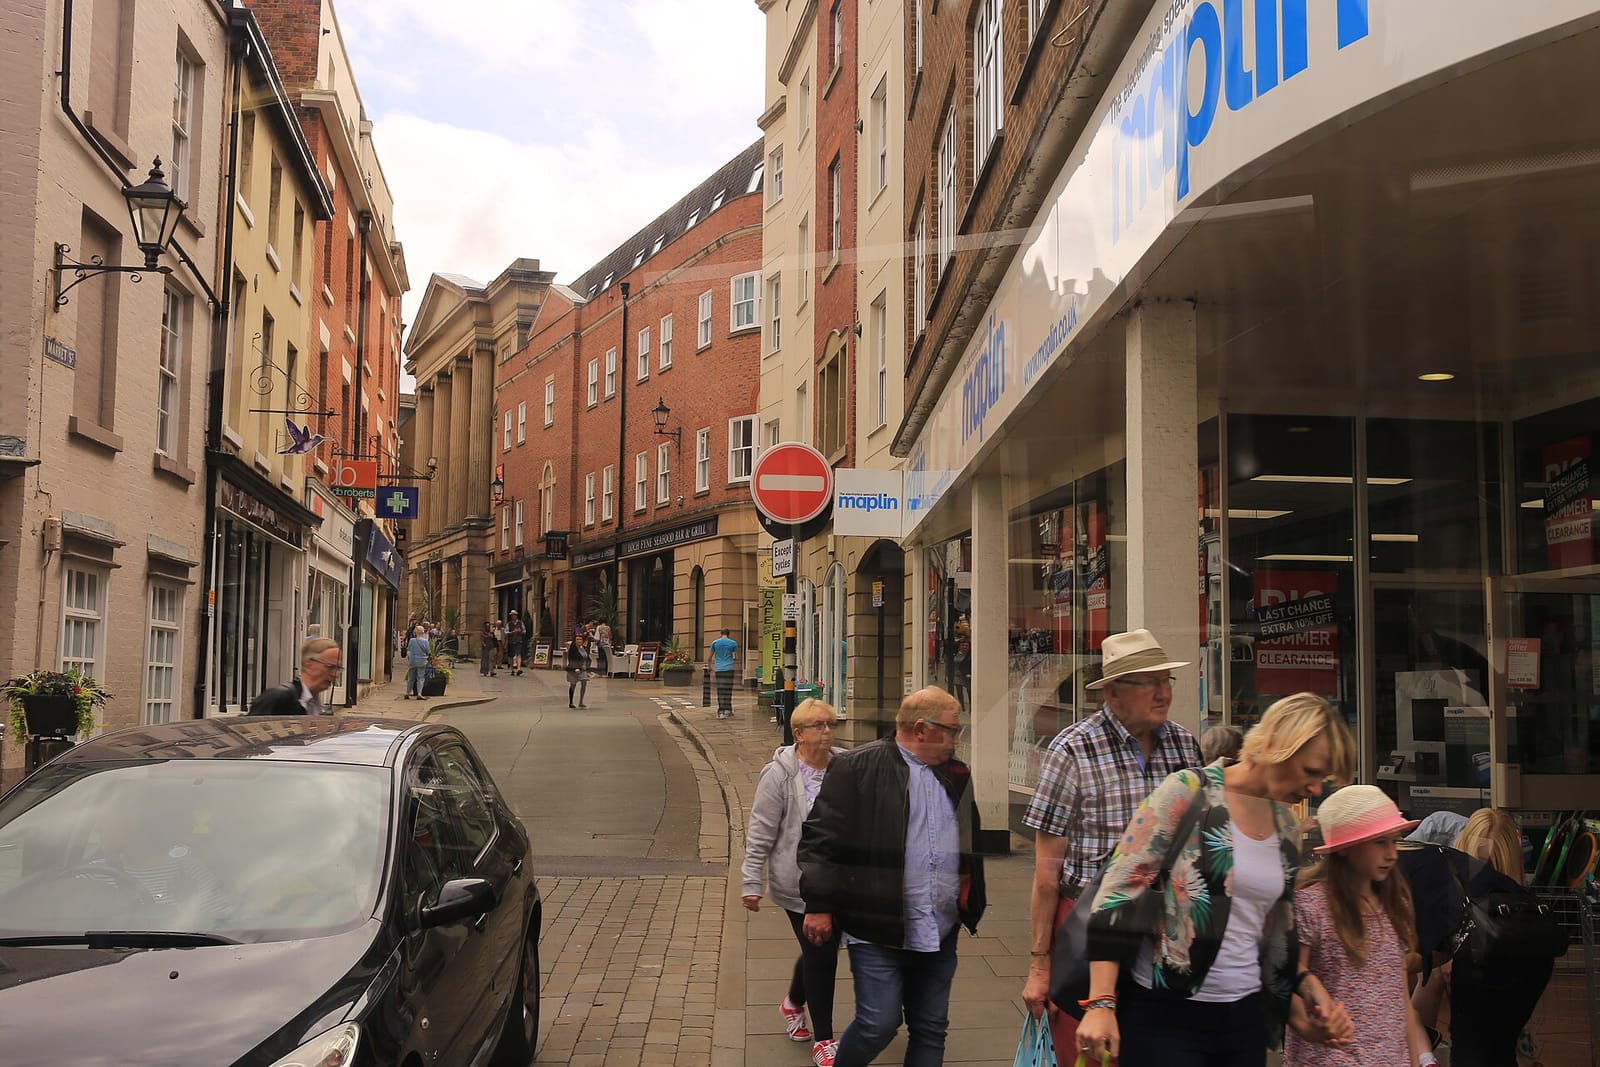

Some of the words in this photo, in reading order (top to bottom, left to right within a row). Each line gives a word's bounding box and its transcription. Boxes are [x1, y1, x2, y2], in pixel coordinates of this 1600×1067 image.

[1110, 95, 1122, 124] The
[1123, 26, 1161, 103] electronics
[961, 308, 1005, 446] maplin
[344, 488, 374, 498] roberts
[838, 493, 898, 512] maplin
[654, 531, 674, 546] SEAFOOD
[675, 529, 684, 541] BAR
[692, 523, 706, 537] GRILL
[1548, 522, 1589, 540] CLEARANCE
[774, 544, 792, 558] Except
[775, 559, 790, 572] cycles
[1258, 605, 1286, 622] LAST
[1288, 598, 1332, 616] CHANCE
[1261, 621, 1294, 636] EXTRA
[1295, 615, 1314, 628] 10%
[1315, 612, 1334, 625] OFF
[1260, 653, 1332, 666] CLEARANCE
